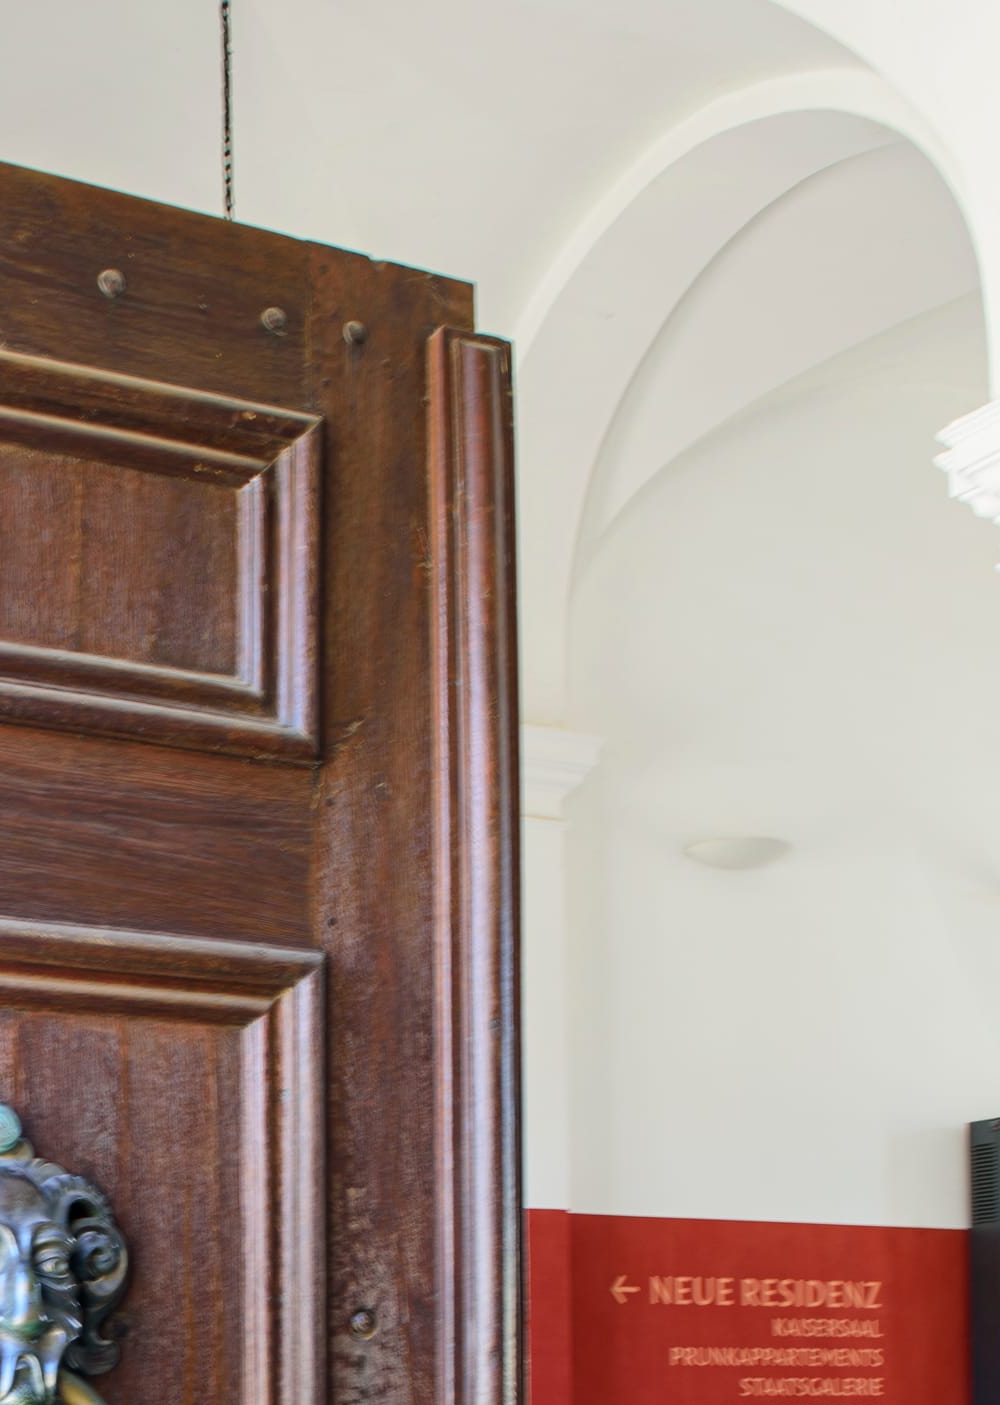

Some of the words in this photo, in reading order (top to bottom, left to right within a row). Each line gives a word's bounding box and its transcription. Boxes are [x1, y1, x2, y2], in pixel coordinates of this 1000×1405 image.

[649, 1276, 735, 1306] NEUE
[740, 1278, 883, 1309] RESIDENZ
[771, 1318, 884, 1338] KAISERSAAL
[668, 1347, 884, 1367] PRUNKAPPARTEMENTS
[739, 1377, 885, 1396] STAATSGALERIE
